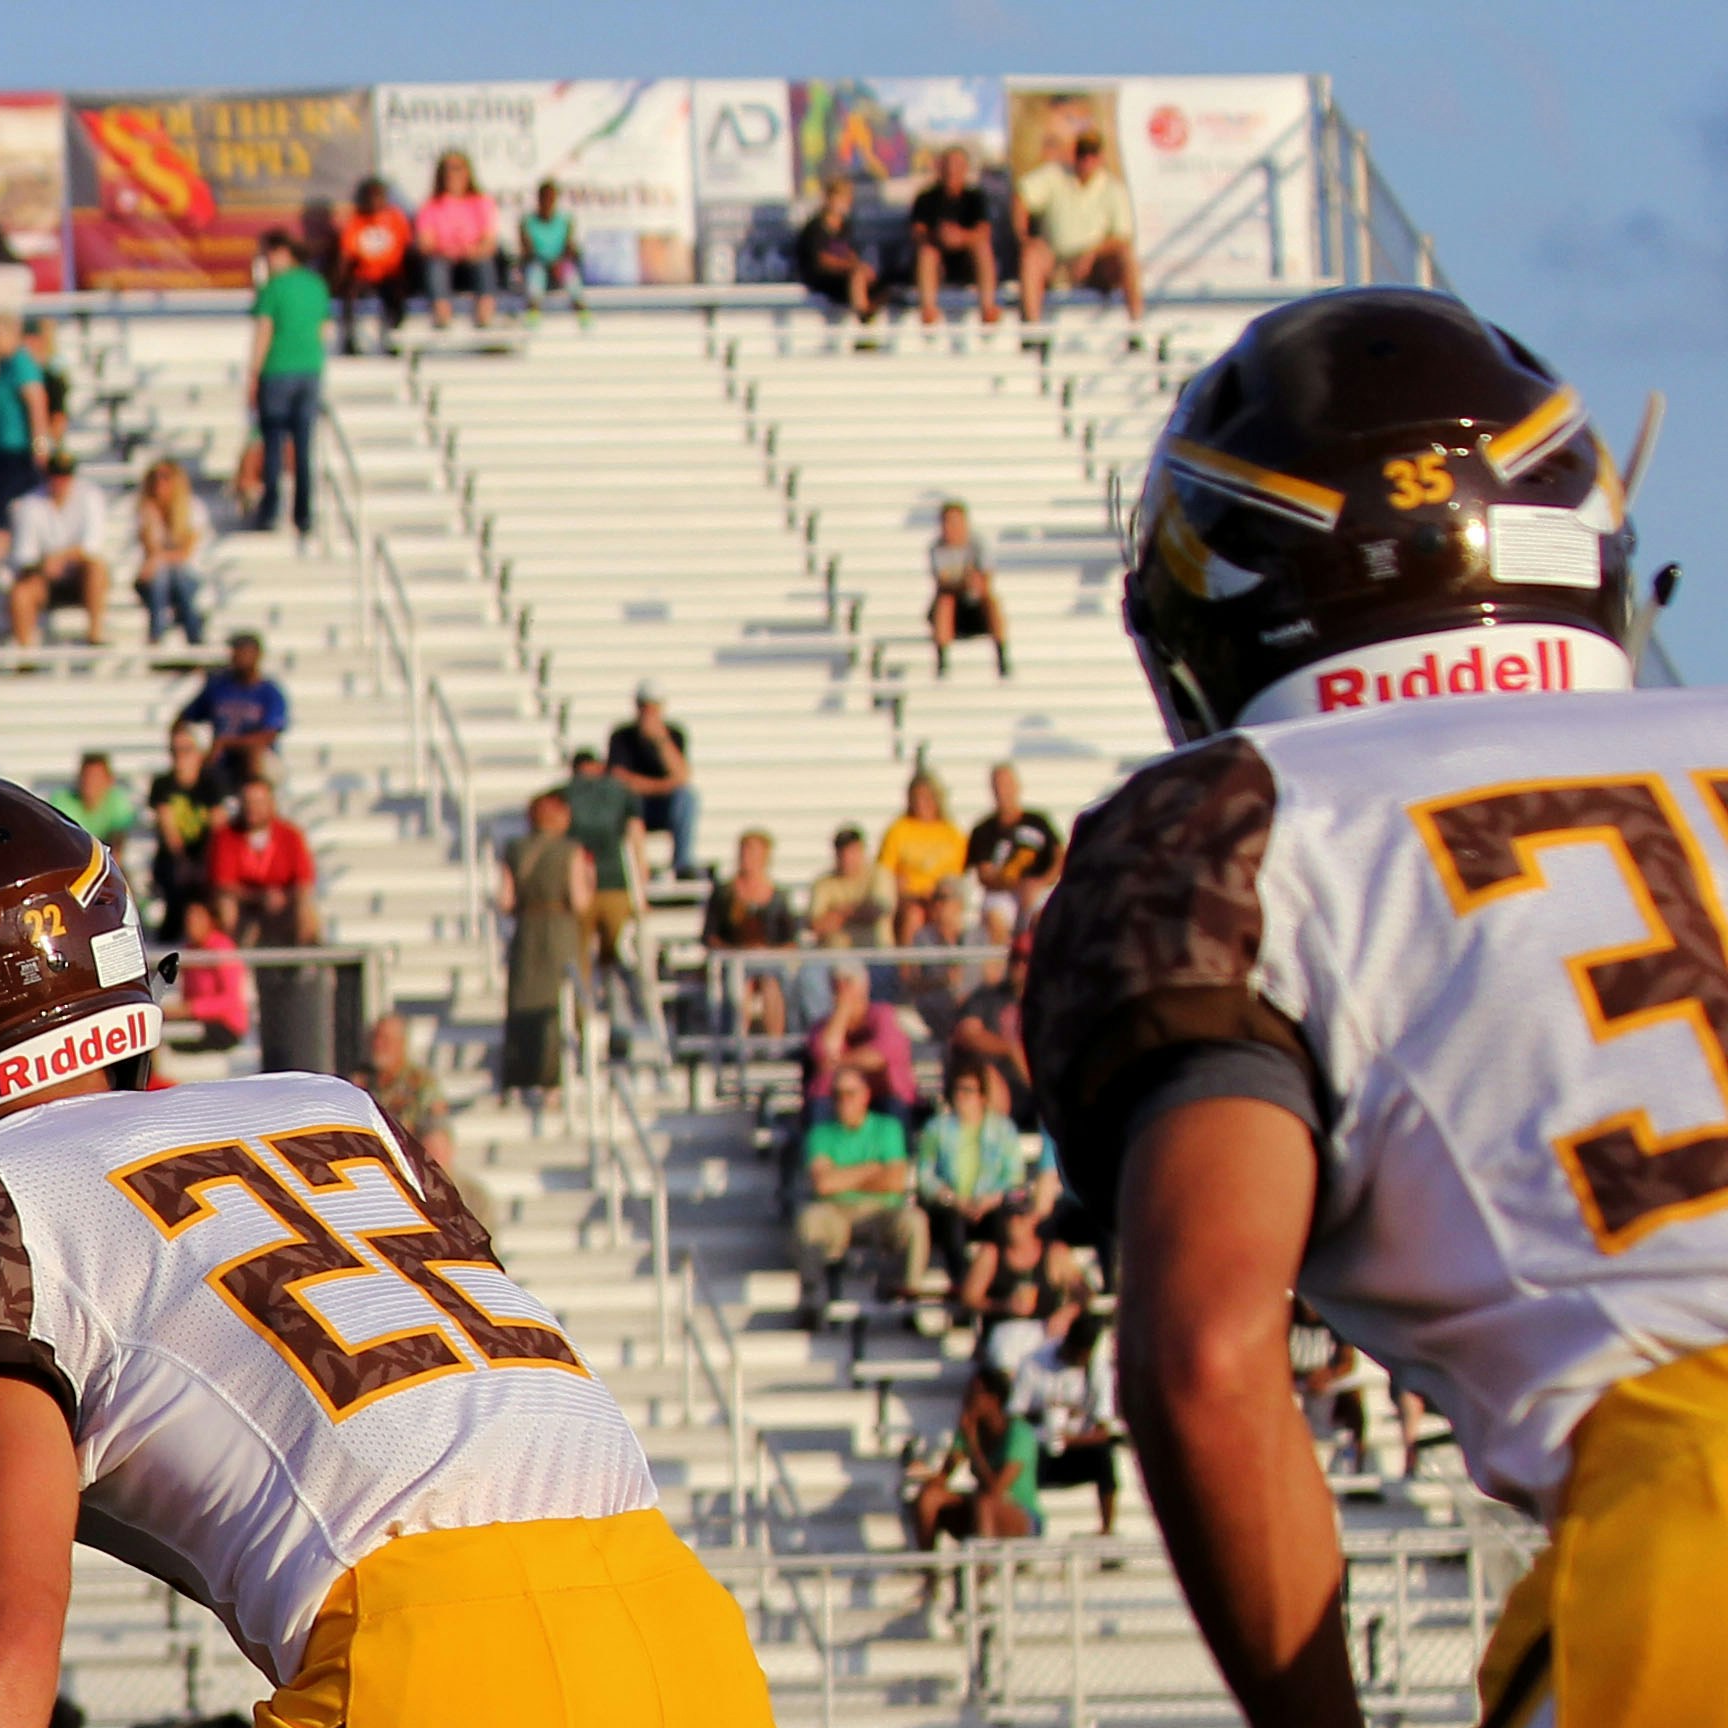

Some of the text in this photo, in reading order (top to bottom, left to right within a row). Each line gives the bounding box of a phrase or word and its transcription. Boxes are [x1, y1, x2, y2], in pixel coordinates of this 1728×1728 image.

[1382, 451, 1455, 510] 35
[1316, 638, 1573, 713] Riddell
[24, 903, 67, 947] 22
[1406, 770, 1728, 1256] 3
[106, 1123, 592, 1425] 22
